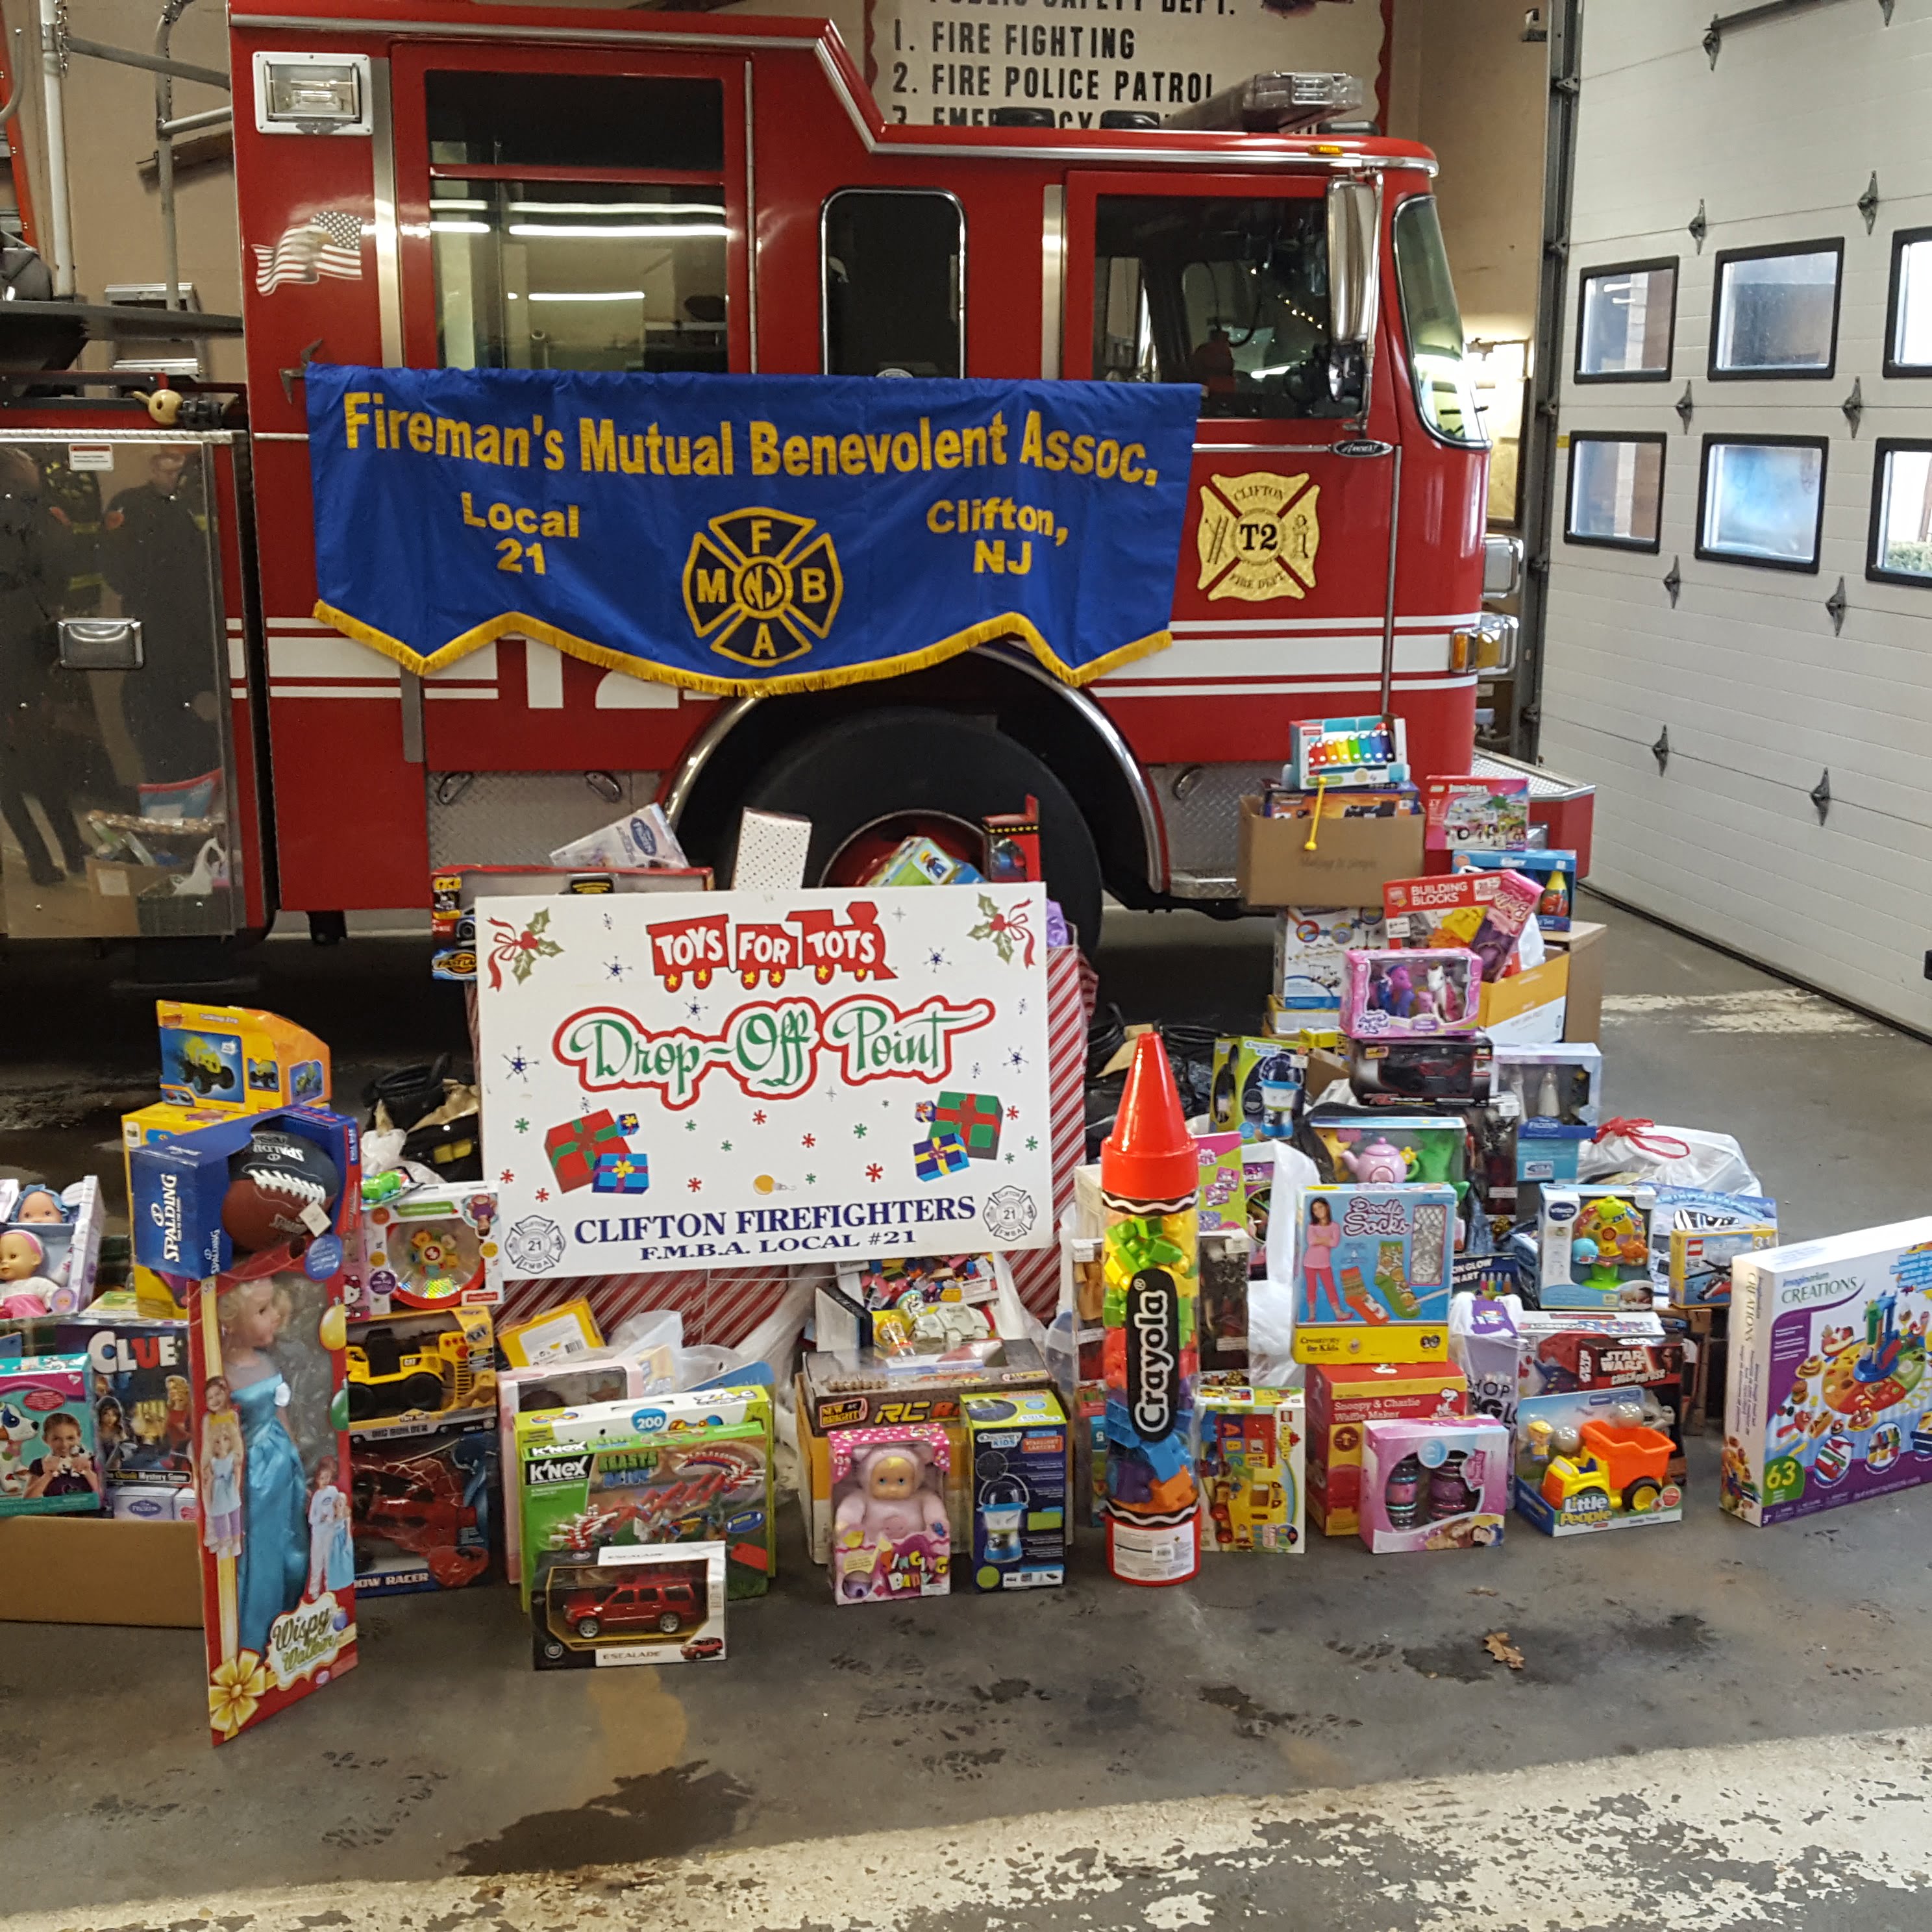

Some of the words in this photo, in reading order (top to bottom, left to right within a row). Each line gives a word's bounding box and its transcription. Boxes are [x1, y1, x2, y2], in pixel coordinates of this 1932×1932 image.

[932, 21, 991, 55] FIRE
[1005, 23, 1135, 60] FIGHTING
[893, 60, 918, 95] 2.
[932, 64, 991, 97] FIRE
[1004, 66, 1100, 100] POLICE
[343, 391, 565, 472] Fireman's
[578, 417, 734, 476] Mutual
[749, 410, 1008, 476] Benevolent
[1232, 486, 1285, 502] CLIFTON
[460, 491, 580, 539] Local
[927, 496, 1069, 547] Clifton,
[751, 520, 771, 554] F
[1239, 523, 1278, 551] T2
[495, 538, 547, 576] 21
[972, 539, 1032, 575] NJ
[1228, 573, 1254, 590] FIRE
[752, 623, 777, 658] A
[1411, 882, 1468, 896] BUILDING
[1412, 893, 1459, 906] BLOCKS
[655, 926, 724, 967] TOYS
[739, 929, 790, 966] FOR
[806, 925, 878, 963] TOTS
[569, 1008, 810, 1098] Drop-Off
[832, 1005, 989, 1074] Point
[160, 1174, 180, 1263] SPALDING
[574, 1211, 727, 1245] CLIFTON
[735, 1195, 977, 1234] FIREFIGHTERS
[1003, 1209, 1016, 1220] 21
[1350, 1196, 1405, 1215] Doodle
[1344, 1211, 1411, 1237] Socks
[210, 1228, 221, 1275] SPALDING
[528, 1240, 542, 1252] 21
[639, 1241, 751, 1261] F.M.B.A.
[759, 1233, 860, 1254] LOCAL
[867, 1230, 917, 1246] #21
[1461, 1272, 1480, 1282] ART
[1465, 1258, 1493, 1271] GLOW
[1781, 1276, 1859, 1305] CREATIONS
[1745, 1272, 1756, 1343] CREATIONS
[87, 1330, 180, 1374] CLUE
[1133, 1289, 1175, 1433] Crayola
[1600, 1360, 1646, 1372] WARS
[1605, 1350, 1645, 1361] STAR
[1333, 1402, 1372, 1412] Snoopy
[1372, 1399, 1382, 1408] &
[1383, 1398, 1421, 1407] Charlie
[636, 1417, 663, 1428] 200
[993, 1438, 1016, 1446] KIDS
[1766, 1460, 1796, 1489] 63
[1560, 1509, 1613, 1527] People
[1565, 1495, 1608, 1513] Little
[384, 1573, 429, 1586] RACER
[272, 1607, 330, 1652] Wispy
[602, 1650, 661, 1660] ESCALADE
